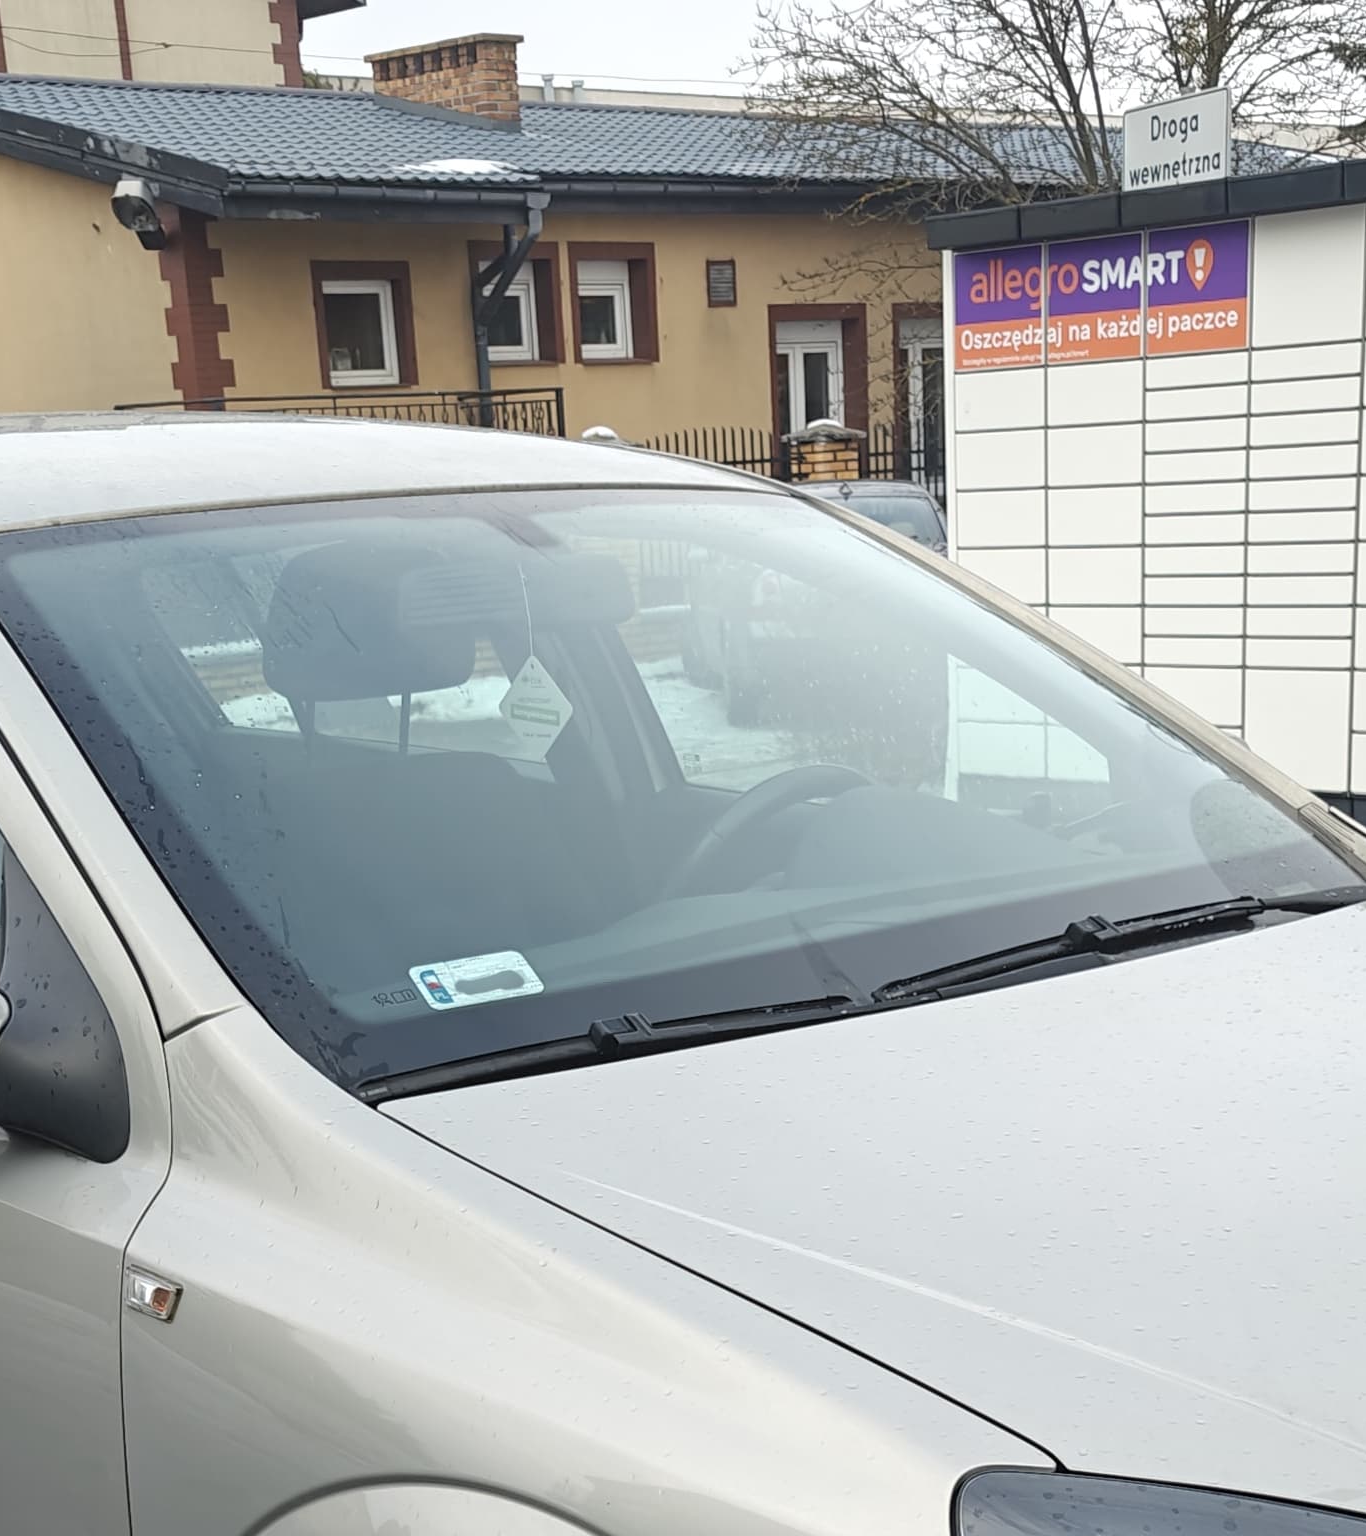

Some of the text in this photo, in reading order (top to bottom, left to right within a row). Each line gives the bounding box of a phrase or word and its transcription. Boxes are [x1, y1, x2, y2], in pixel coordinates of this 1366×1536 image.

[1151, 113, 1199, 143] Droga
[970, 258, 1079, 311] allegro
[960, 309, 1238, 352] Oszczędzaj na każdej paczce
